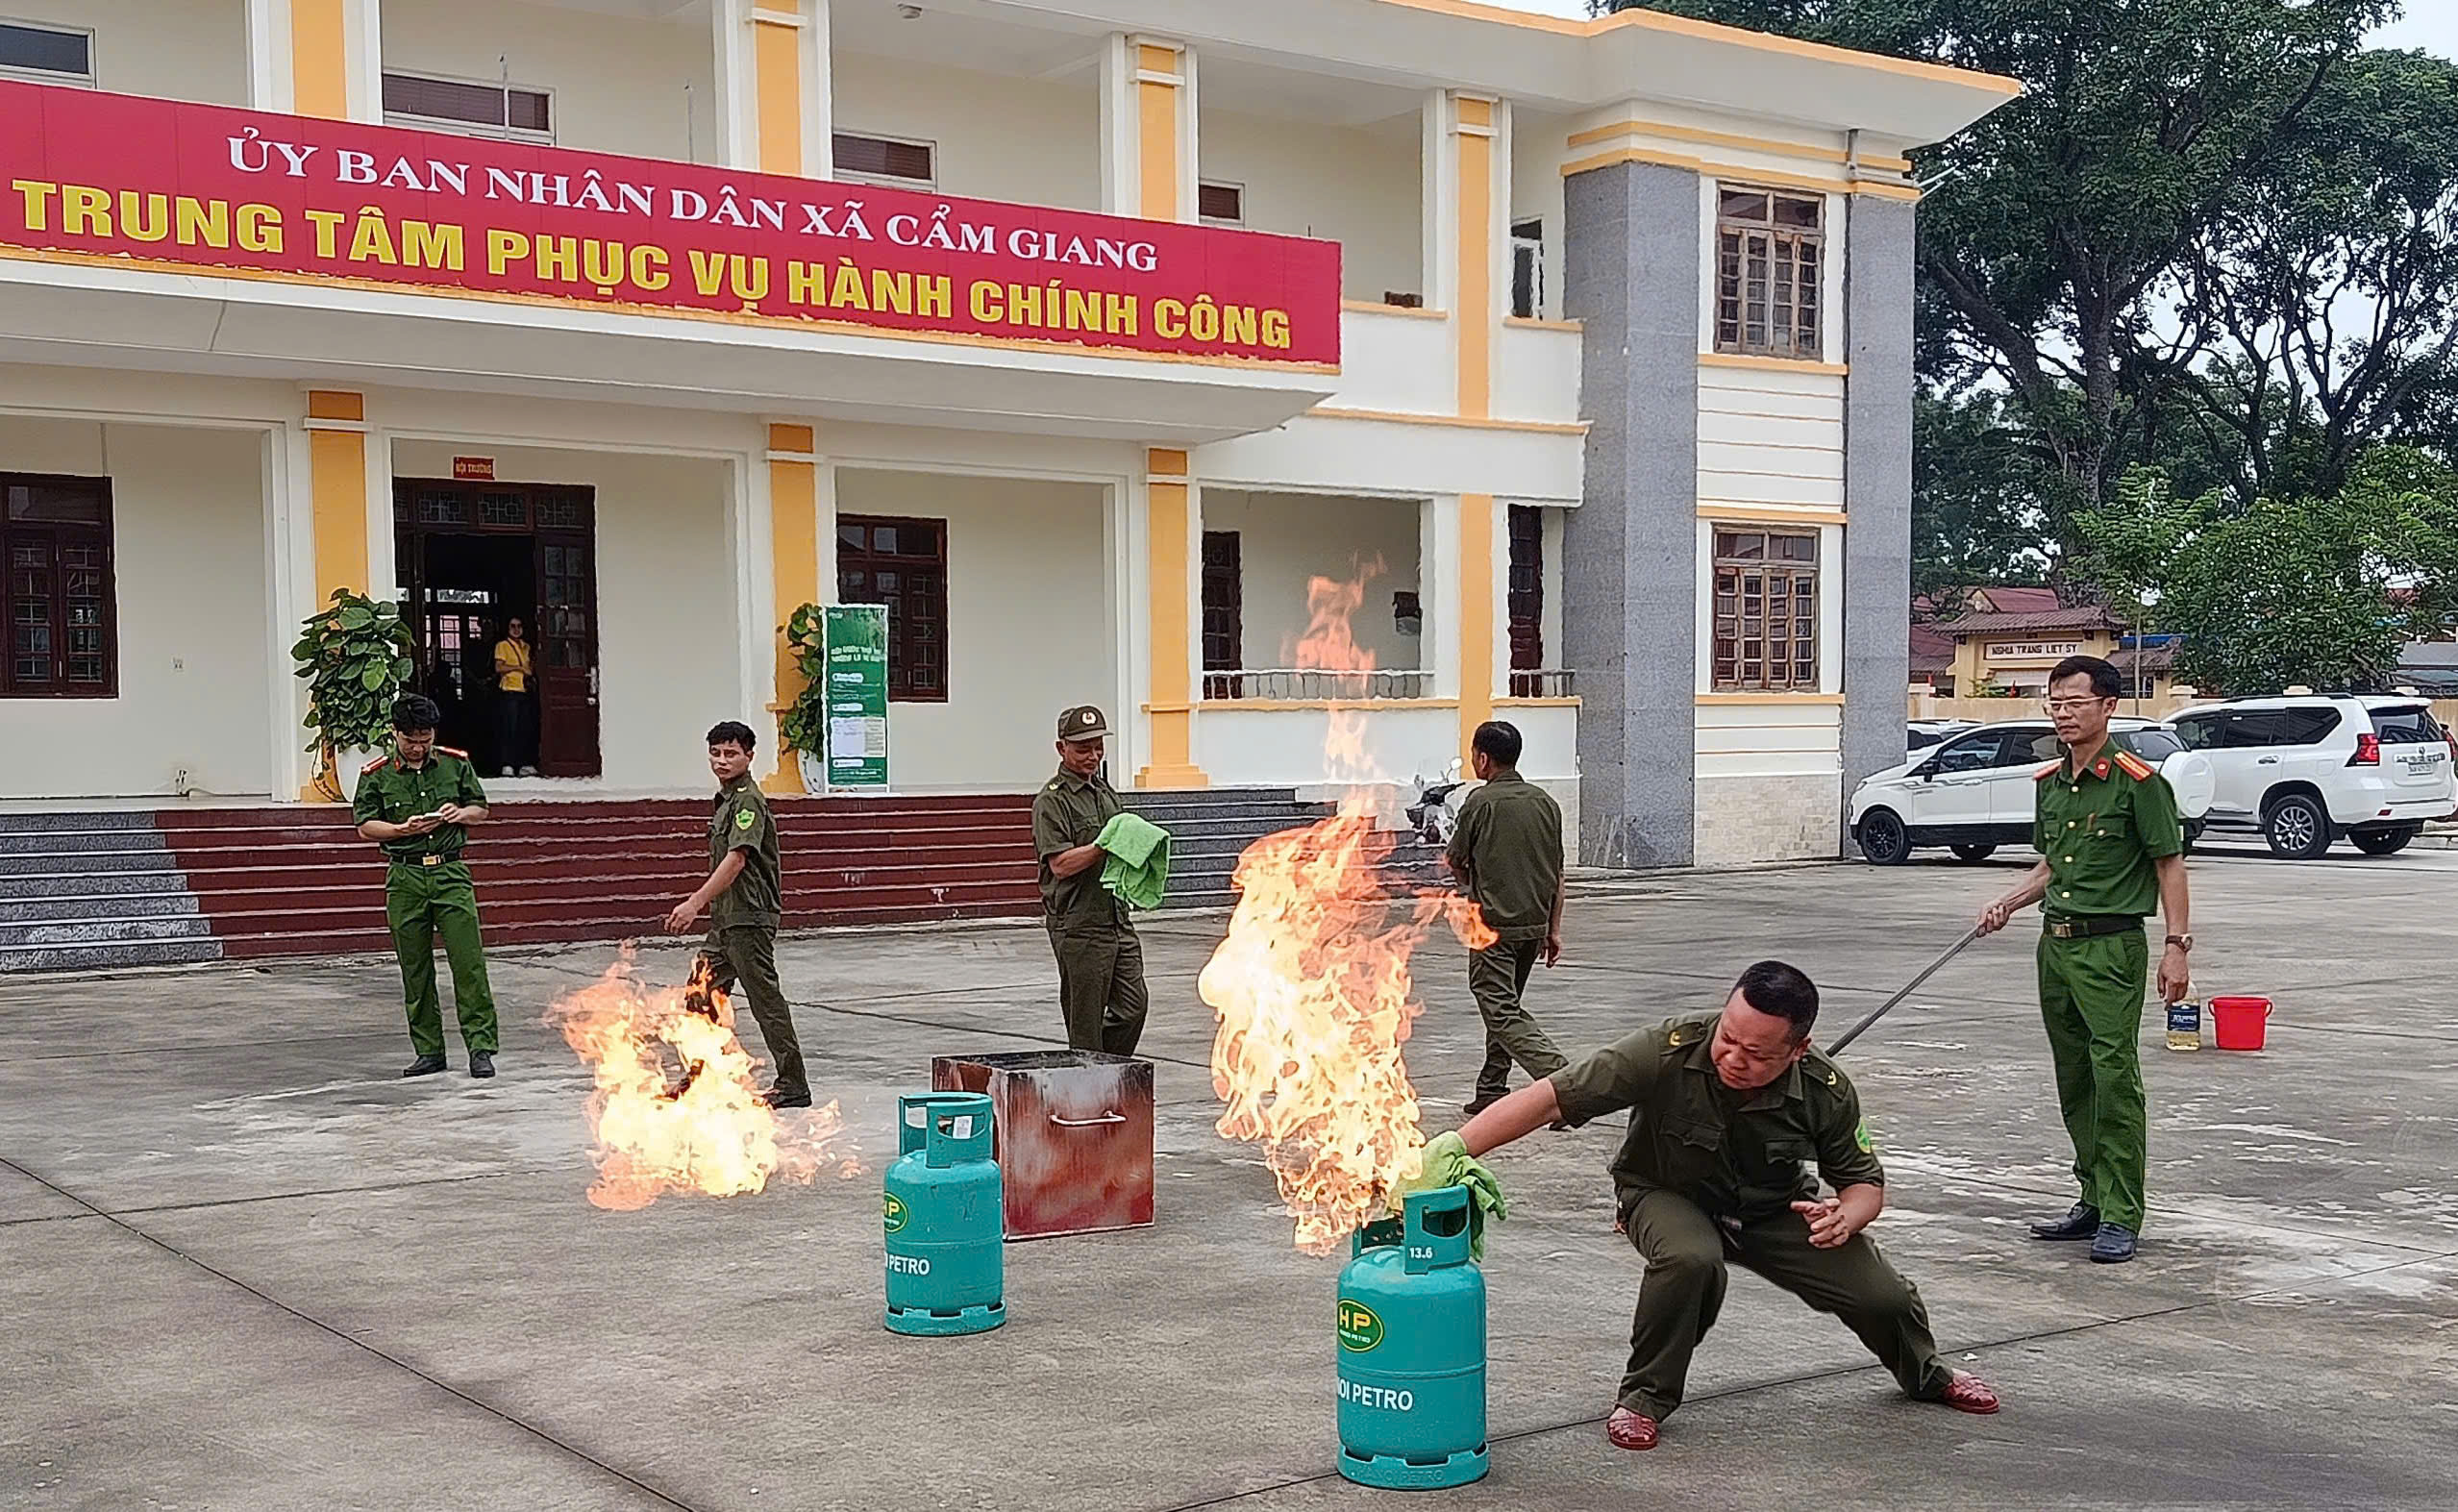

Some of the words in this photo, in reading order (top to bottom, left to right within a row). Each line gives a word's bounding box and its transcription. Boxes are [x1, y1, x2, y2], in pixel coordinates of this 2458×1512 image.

[227, 126, 319, 177] ỦY
[335, 149, 470, 196] BAN
[484, 167, 656, 217] NHÂN
[670, 185, 787, 232] DÂN
[800, 200, 874, 240] XÃ
[886, 204, 997, 255] CẨM
[1007, 229, 1157, 271] GIANG
[12, 180, 284, 253] TRUNG
[307, 206, 464, 270] TÂM
[487, 230, 670, 296] PHỤC
[688, 251, 768, 309] VỤ
[788, 258, 952, 318] HÀNH
[970, 280, 1137, 335] CHÍNH
[1155, 294, 1291, 348] CÔNG
[889, 1254, 931, 1276] PETRO
[1409, 1247, 1433, 1259] 13.6
[1339, 1306, 1371, 1331] HP
[1352, 1383, 1413, 1411] PETRO
